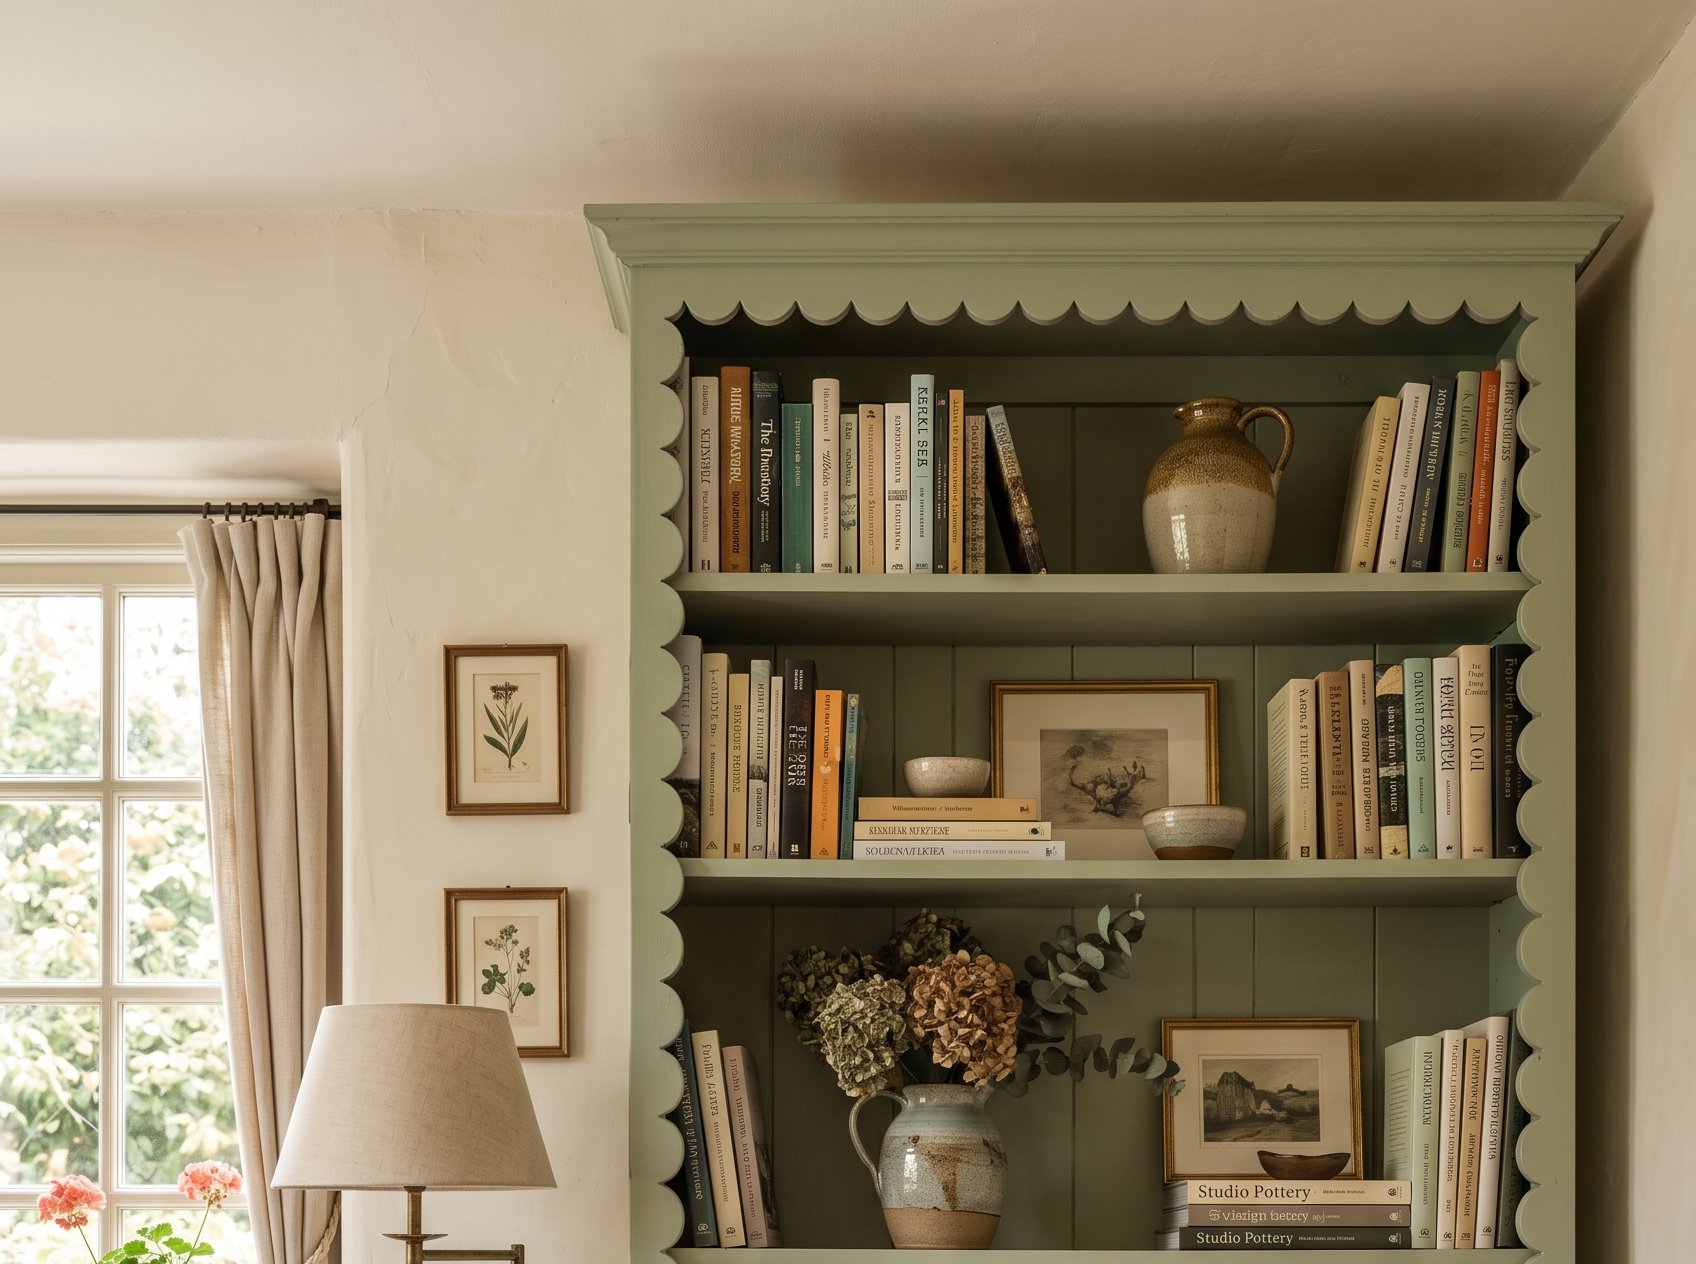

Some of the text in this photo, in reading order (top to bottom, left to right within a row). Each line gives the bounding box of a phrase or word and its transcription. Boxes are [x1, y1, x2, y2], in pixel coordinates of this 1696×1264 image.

[760, 418, 776, 445] The
[1198, 1184, 1311, 1202] Studio Pottery
[1196, 1231, 1293, 1246] Studio Pottery
